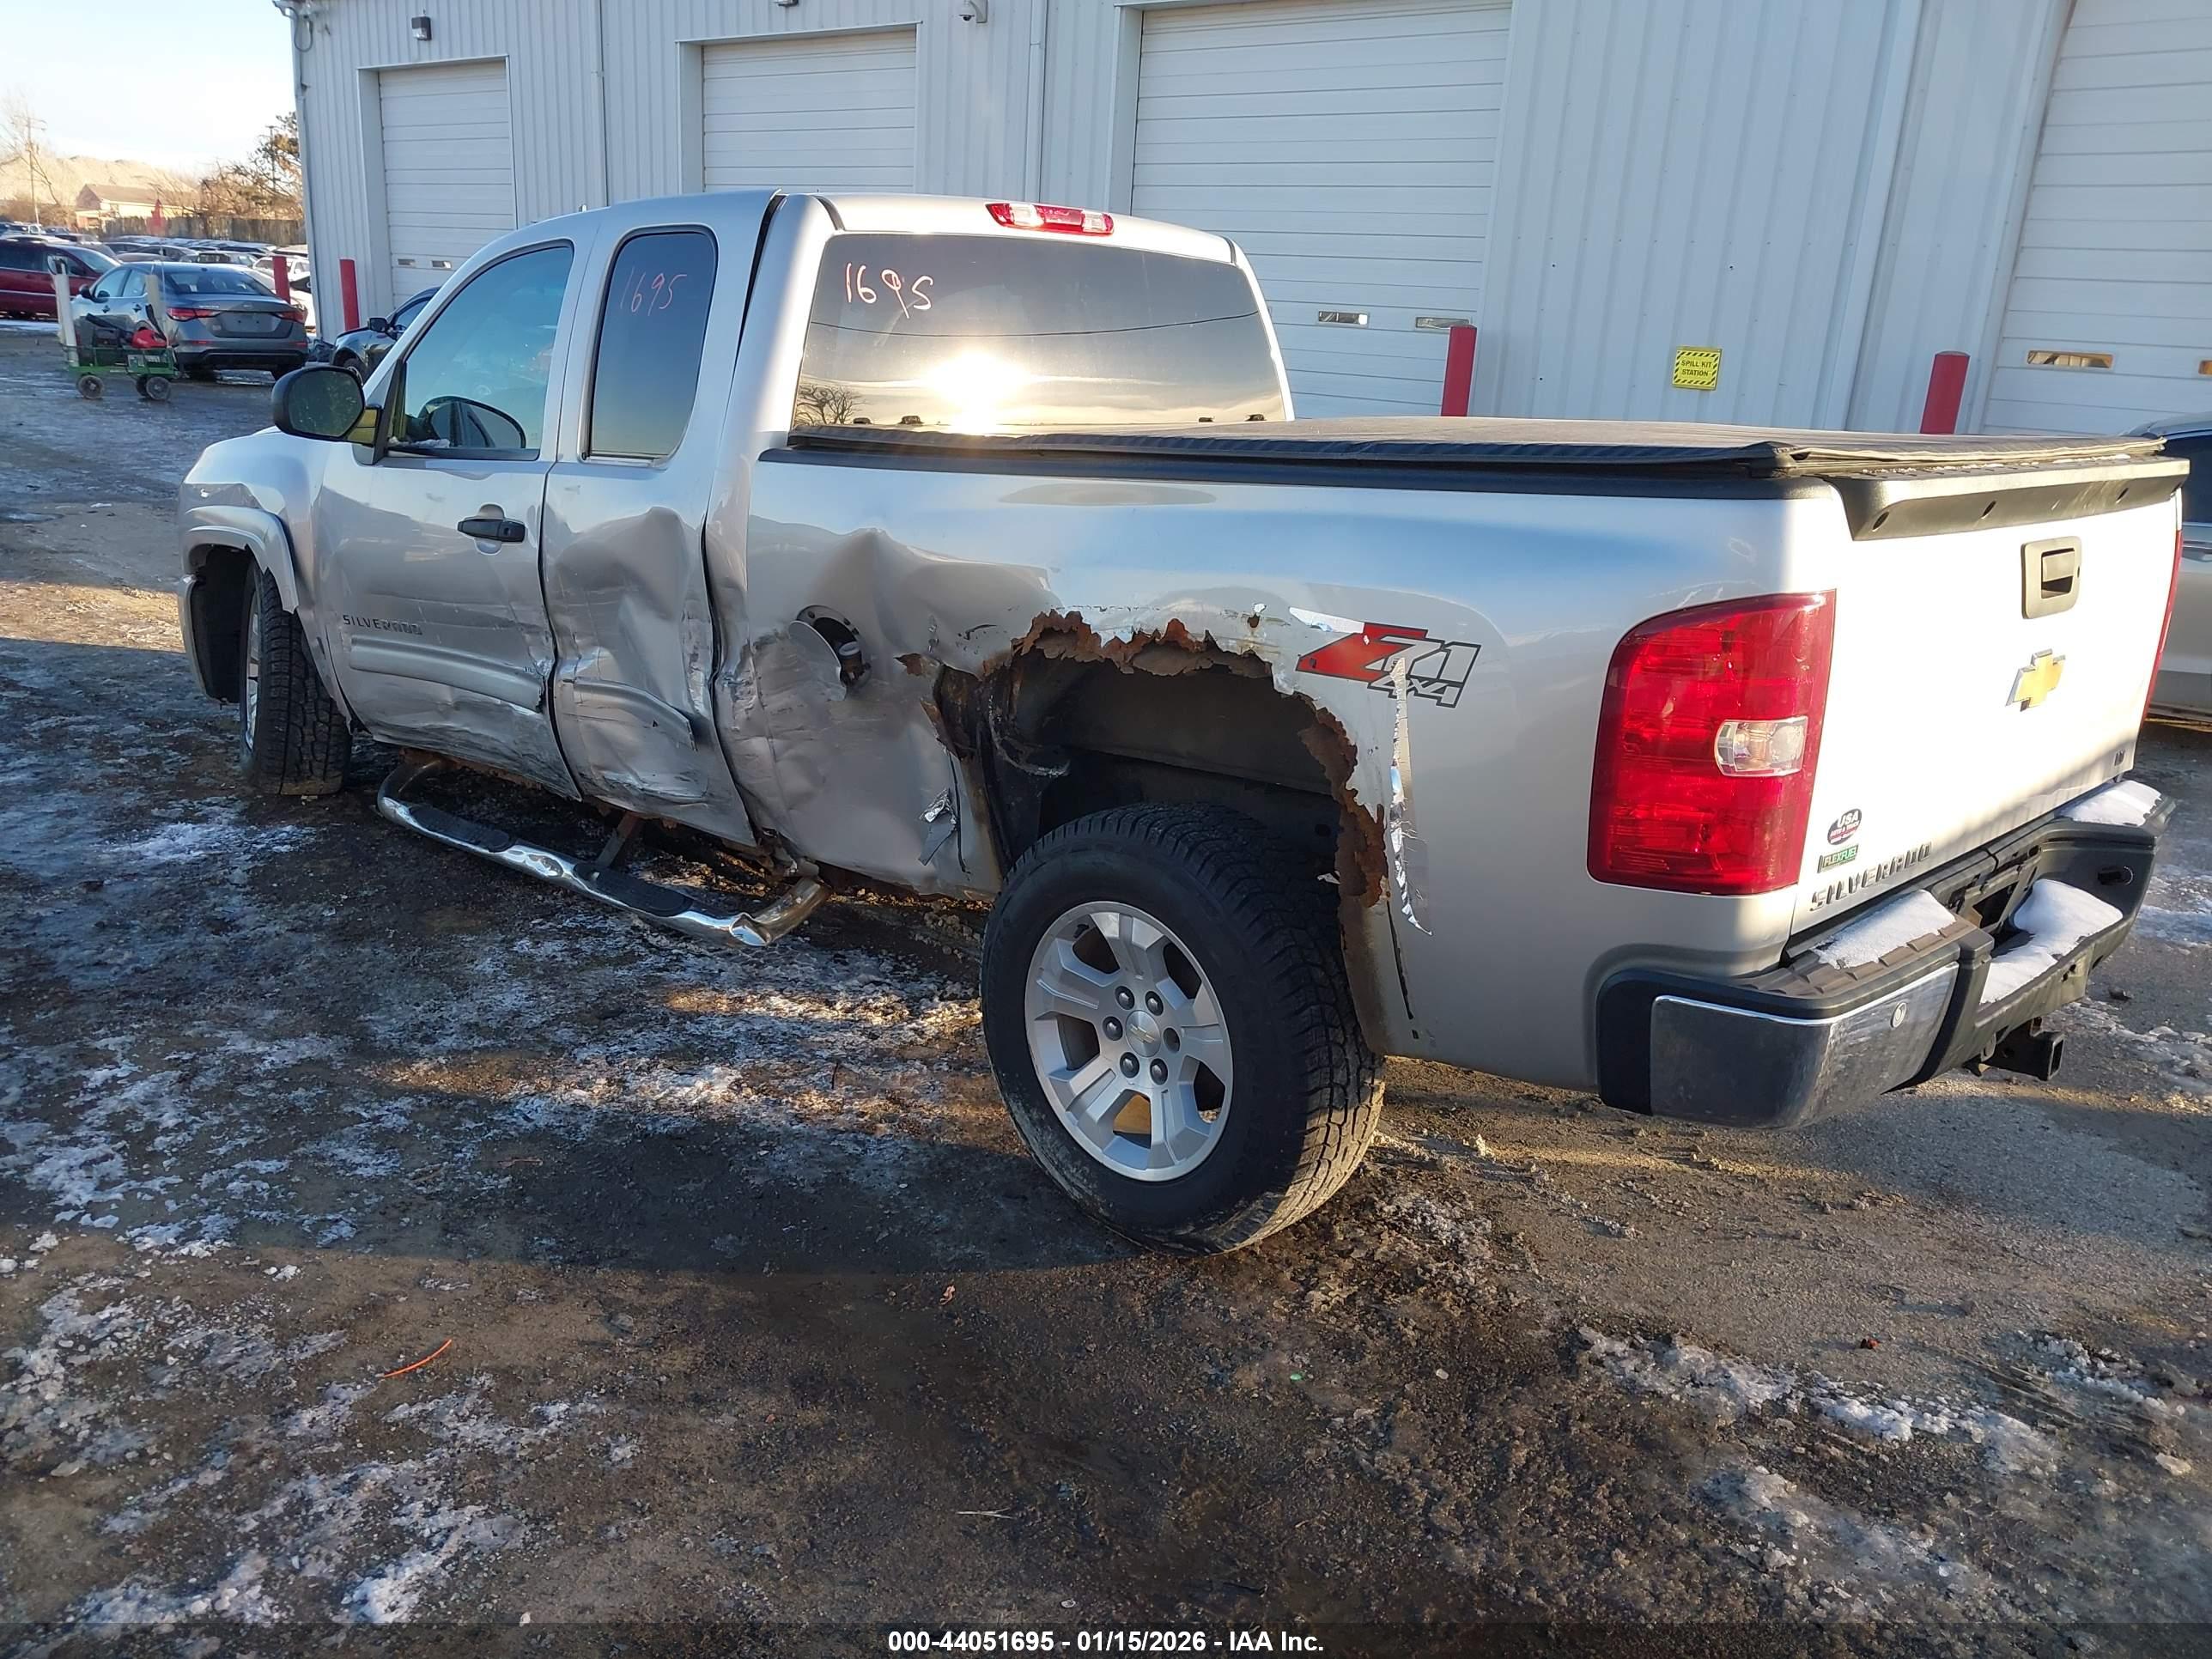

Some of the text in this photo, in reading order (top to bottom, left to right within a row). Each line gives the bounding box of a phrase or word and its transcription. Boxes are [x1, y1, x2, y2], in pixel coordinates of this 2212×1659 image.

[620, 264, 688, 316] 1695
[845, 262, 933, 319] 1695
[1837, 810, 1859, 829] USA
